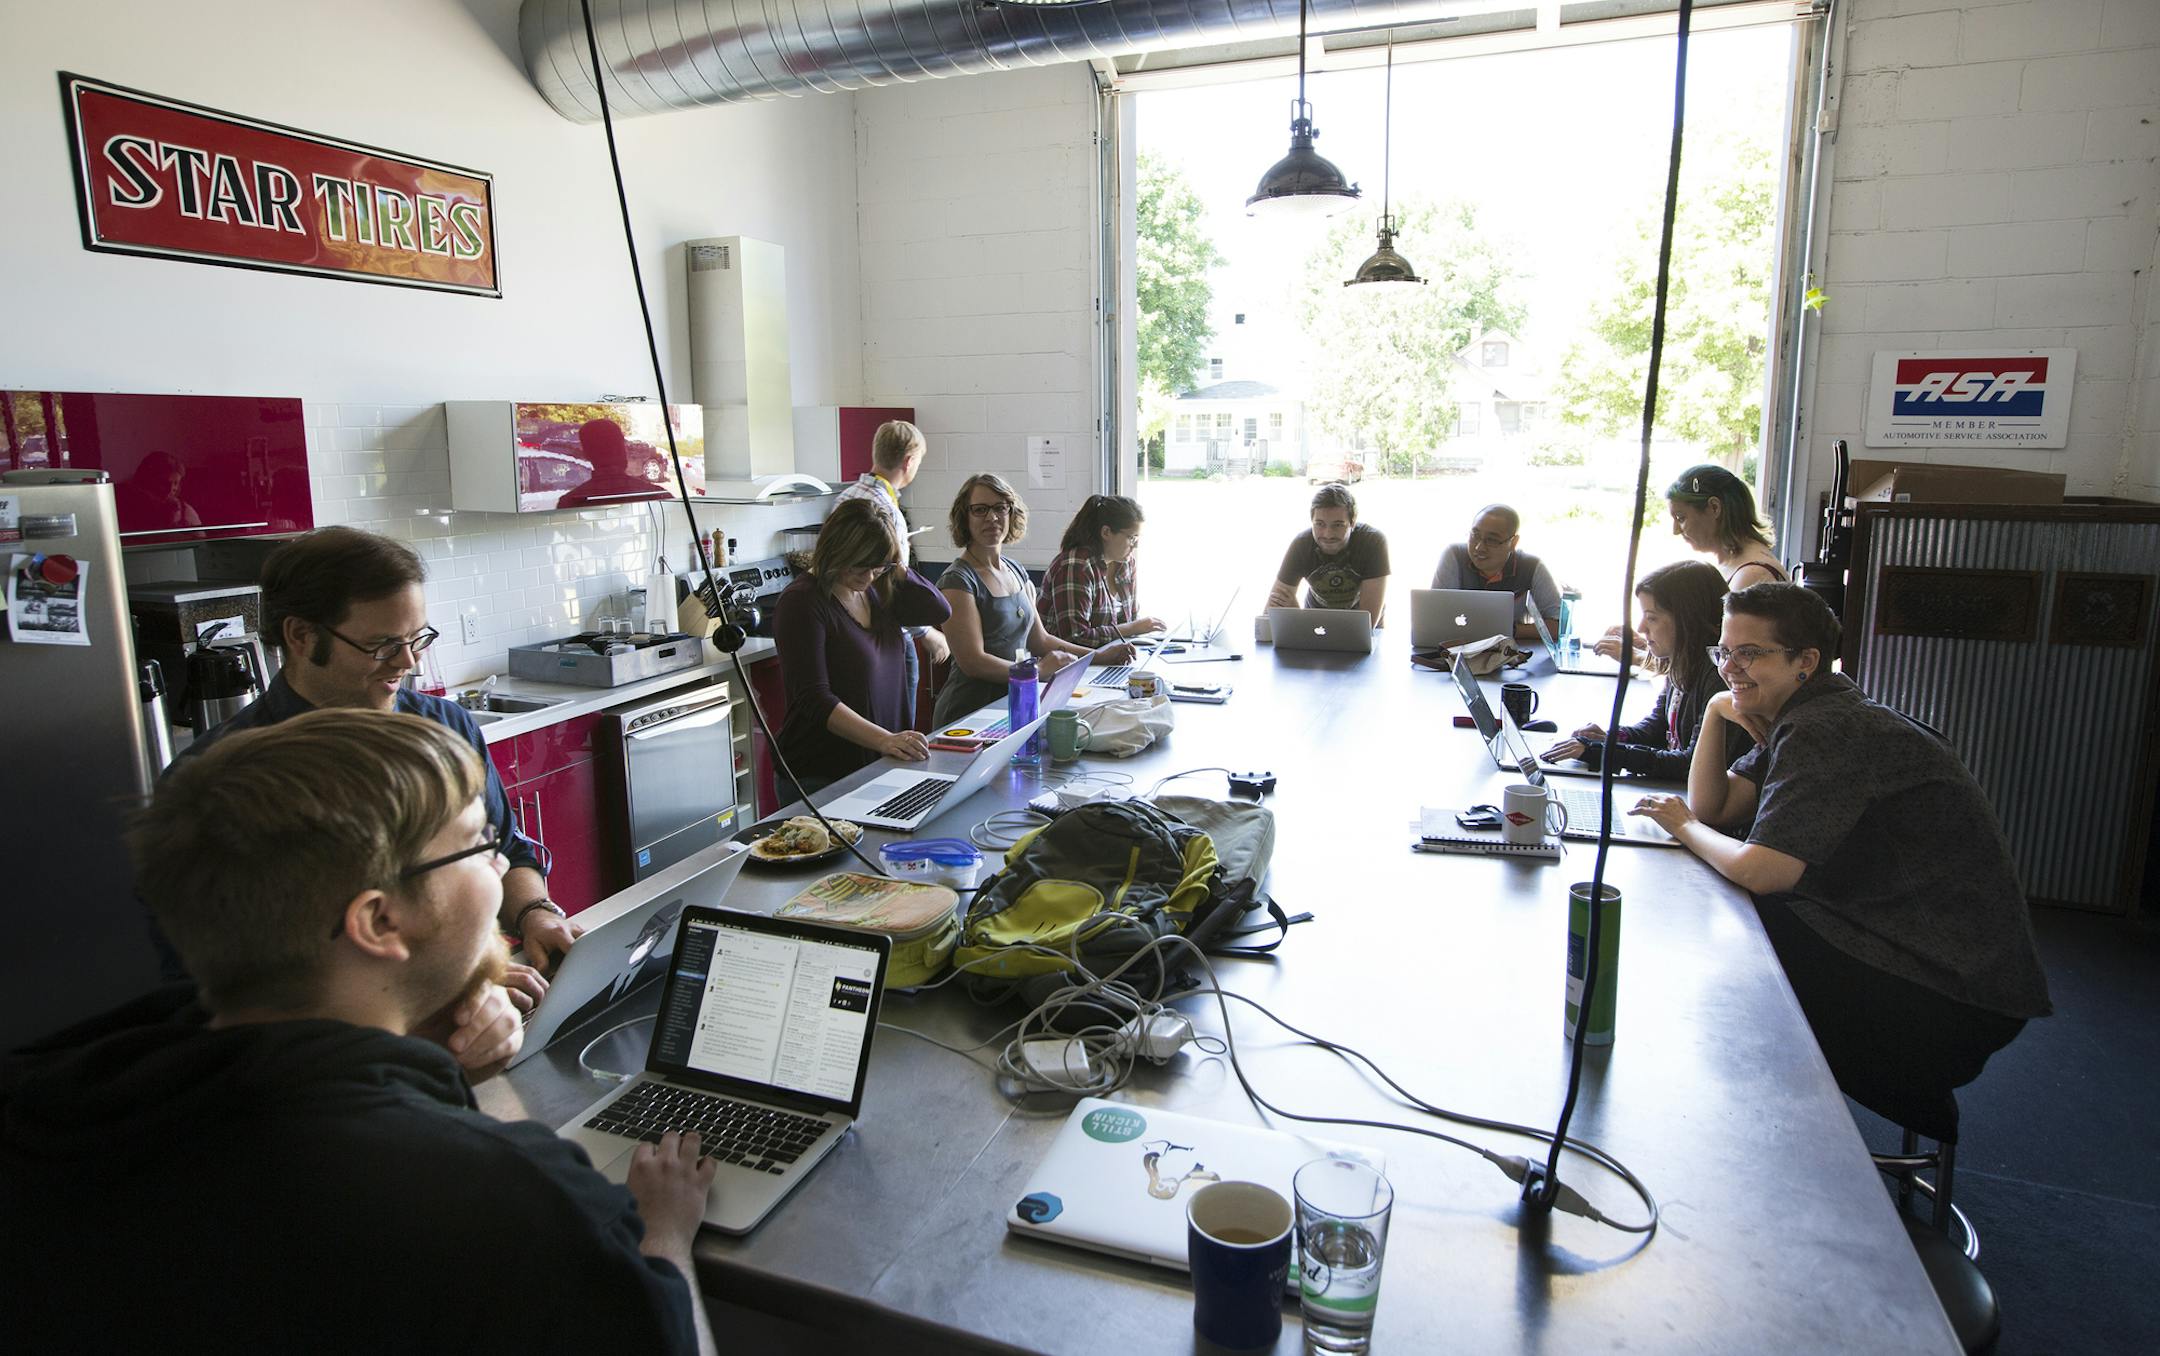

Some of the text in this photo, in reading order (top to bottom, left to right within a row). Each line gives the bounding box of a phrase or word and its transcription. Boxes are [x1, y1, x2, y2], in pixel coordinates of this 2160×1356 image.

[103, 134, 484, 261] STAR TIRES
[1904, 371, 2035, 402] ASA
[1932, 420, 1996, 430] MEMBER
[1882, 432, 2048, 440] AUTOMOTIVE SERVICE ASSOCIATION
